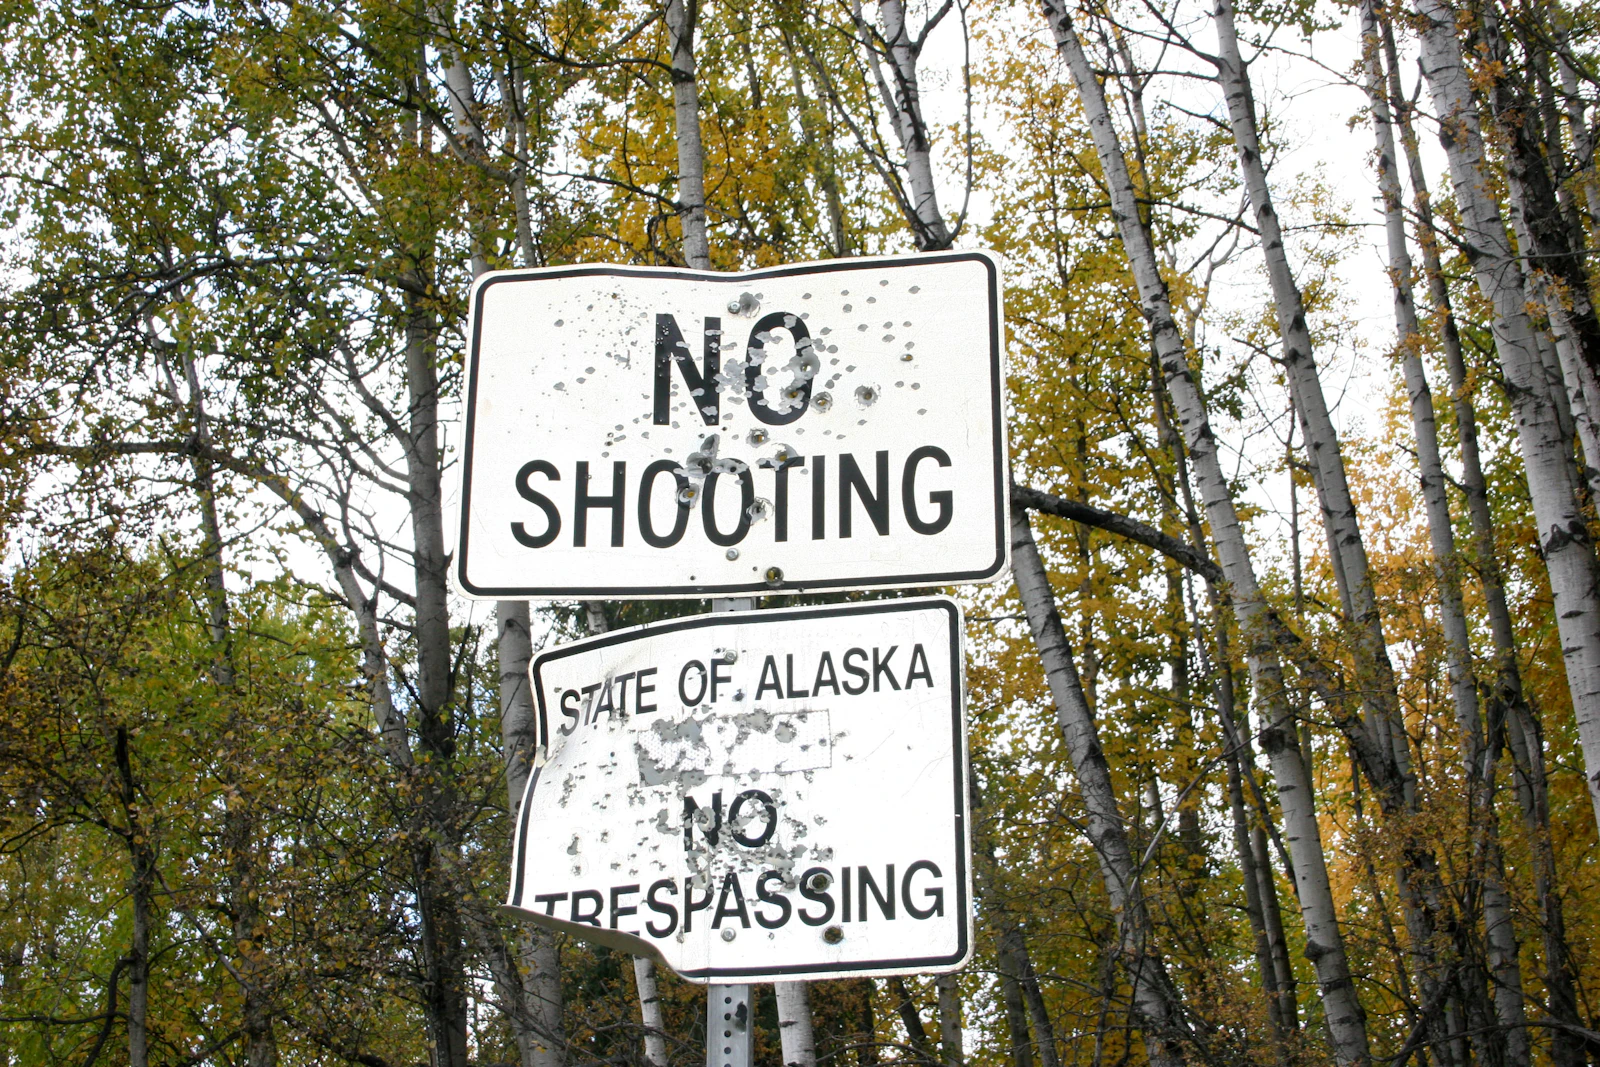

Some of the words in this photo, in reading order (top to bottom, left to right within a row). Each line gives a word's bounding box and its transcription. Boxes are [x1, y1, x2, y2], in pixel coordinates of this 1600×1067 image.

[653, 312, 813, 426] NO
[510, 445, 954, 549] SHOOTING
[559, 667, 658, 736] STATE
[678, 658, 735, 707] OF
[755, 643, 935, 700] ALASKA
[684, 789, 778, 851] NO
[535, 859, 944, 938] TRESPASSING
